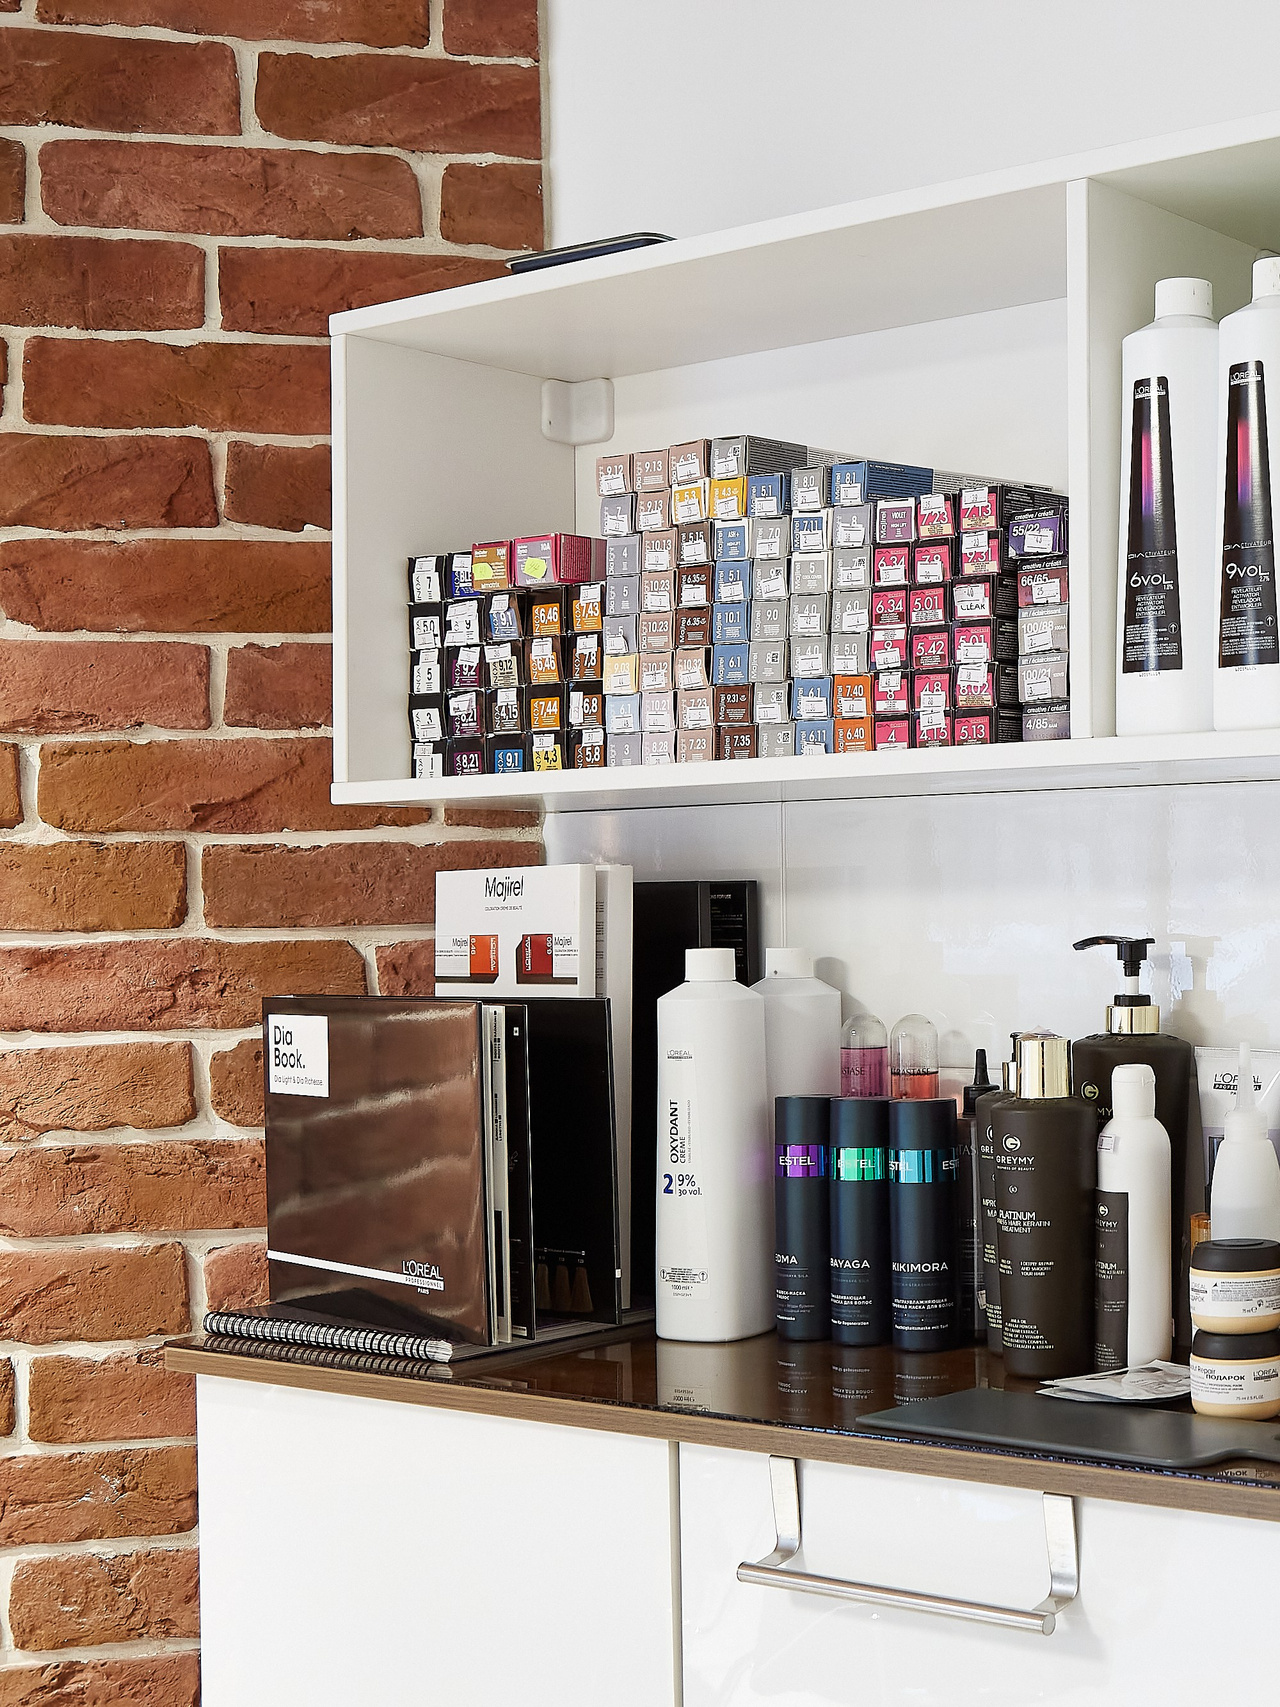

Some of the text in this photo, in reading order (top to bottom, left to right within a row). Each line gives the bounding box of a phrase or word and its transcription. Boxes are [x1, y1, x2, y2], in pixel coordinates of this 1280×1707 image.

[645, 460, 663, 473] 9.13
[761, 485, 772, 497] 5.1
[891, 511, 907, 519] VIOLET
[728, 570, 740, 581] 5.1
[650, 579, 670, 592] 10.23
[876, 599, 904, 614] 6.34
[913, 595, 939, 612] 5.01
[540, 606, 559, 624] 6,46
[724, 611, 741, 624] 10.1
[766, 609, 779, 621] 9.0
[648, 620, 669, 633] 10.23
[916, 640, 945, 657] 5.42
[728, 656, 741, 669] 6.1
[426, 667, 433, 681] 5
[845, 685, 864, 697] 7.40
[726, 693, 740, 704] 9.31
[540, 700, 558, 717] 7,44
[583, 697, 598, 715] 6,8
[1025, 718, 1048, 730] 4/85
[846, 727, 865, 740] 6.40
[887, 729, 897, 742] 4
[959, 724, 986, 740] 5.13
[688, 738, 707, 751] 7.23
[733, 735, 751, 748] 7.35
[585, 746, 601, 763] 5,8
[484, 875, 524, 902] Majirel
[452, 937, 469, 949] Majirel
[553, 936, 573, 949] Majirel
[273, 1025, 293, 1046] Dia
[273, 1047, 306, 1069] Book.
[669, 1099, 679, 1164] OXYDANT
[779, 1155, 816, 1167] ESTEL
[837, 1158, 875, 1169] ESTEL
[889, 1161, 914, 1172] STEL
[995, 1155, 1035, 1165] GREYMY
[662, 1173, 696, 1195] 2 9%
[678, 1186, 703, 1197] 30 vol.
[999, 1209, 1036, 1221] PLATINUM
[1001, 1226, 1031, 1234] TREATMENT
[402, 1259, 444, 1280] L'ORÉAL
[892, 1261, 949, 1273] KIKIMORA
[417, 1287, 430, 1295] PARIS
[1197, 1365, 1216, 1375] Repair
